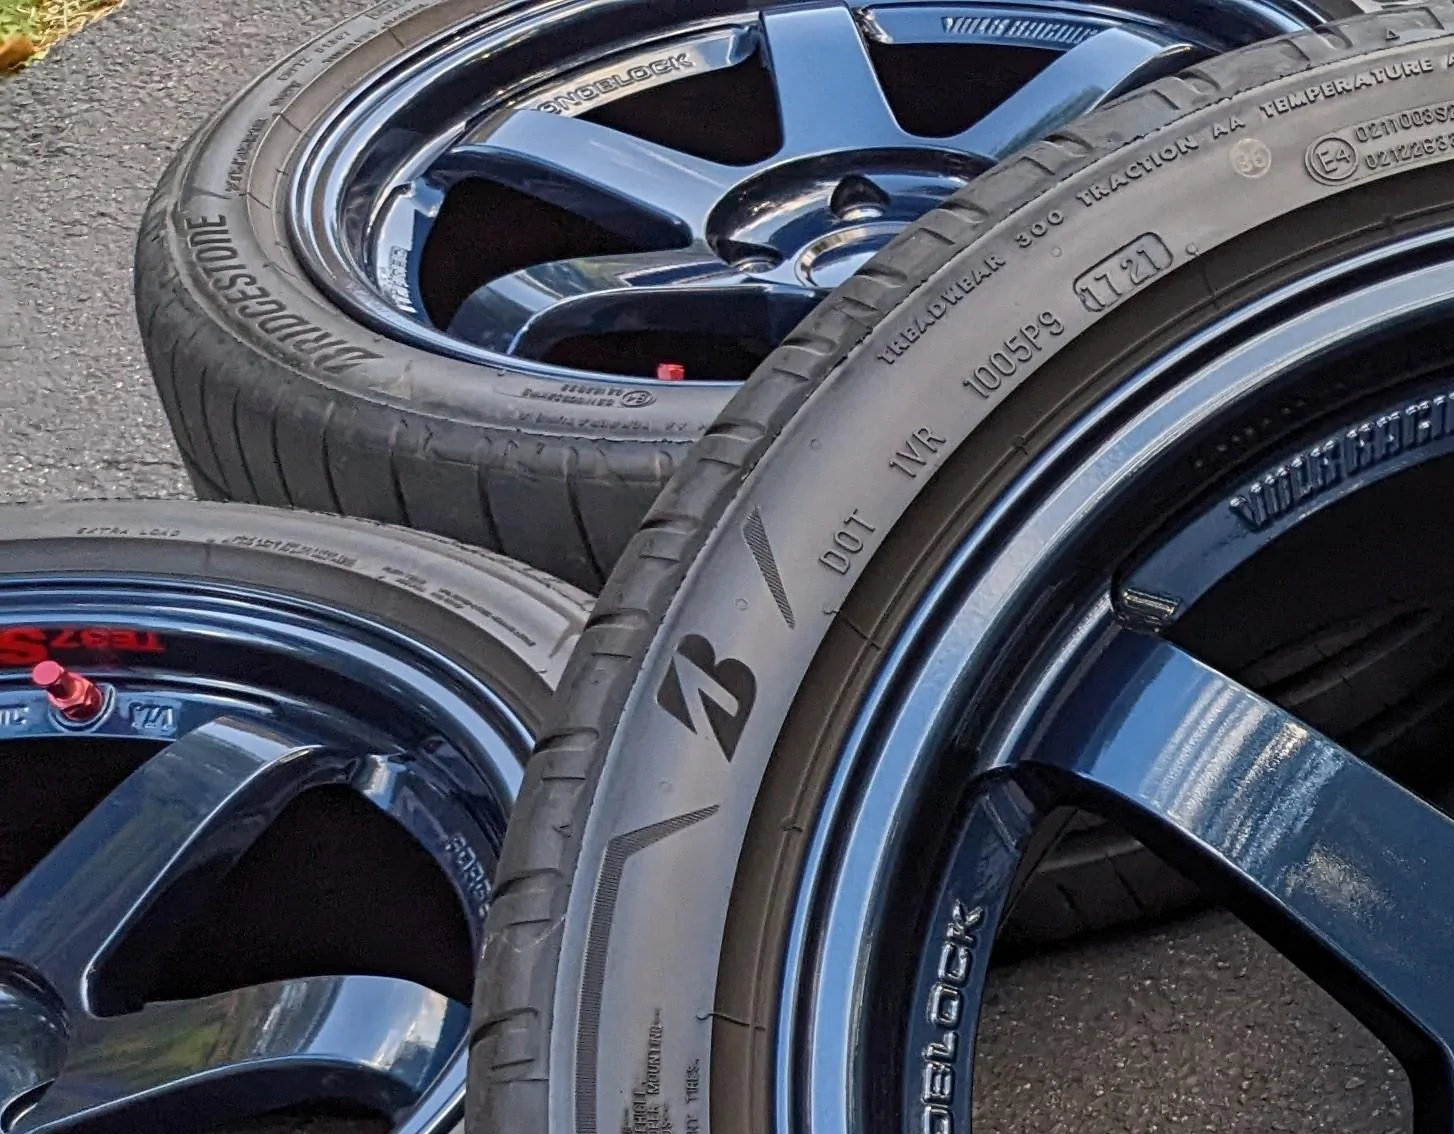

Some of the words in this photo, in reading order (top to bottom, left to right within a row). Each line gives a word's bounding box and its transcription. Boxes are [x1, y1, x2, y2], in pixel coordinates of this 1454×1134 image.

[539, 52, 696, 116] ONOBLOCK
[1315, 141, 1353, 175] E4
[877, 248, 1006, 369] TREADWEAR
[1011, 203, 1066, 250] 300
[1074, 129, 1200, 211] TRACTION
[1208, 110, 1247, 141] AA
[1259, 54, 1433, 121] TEMPERATURE
[818, 506, 878, 576] DOT
[886, 419, 947, 483] 1VR
[961, 305, 1067, 403] 1005P9
